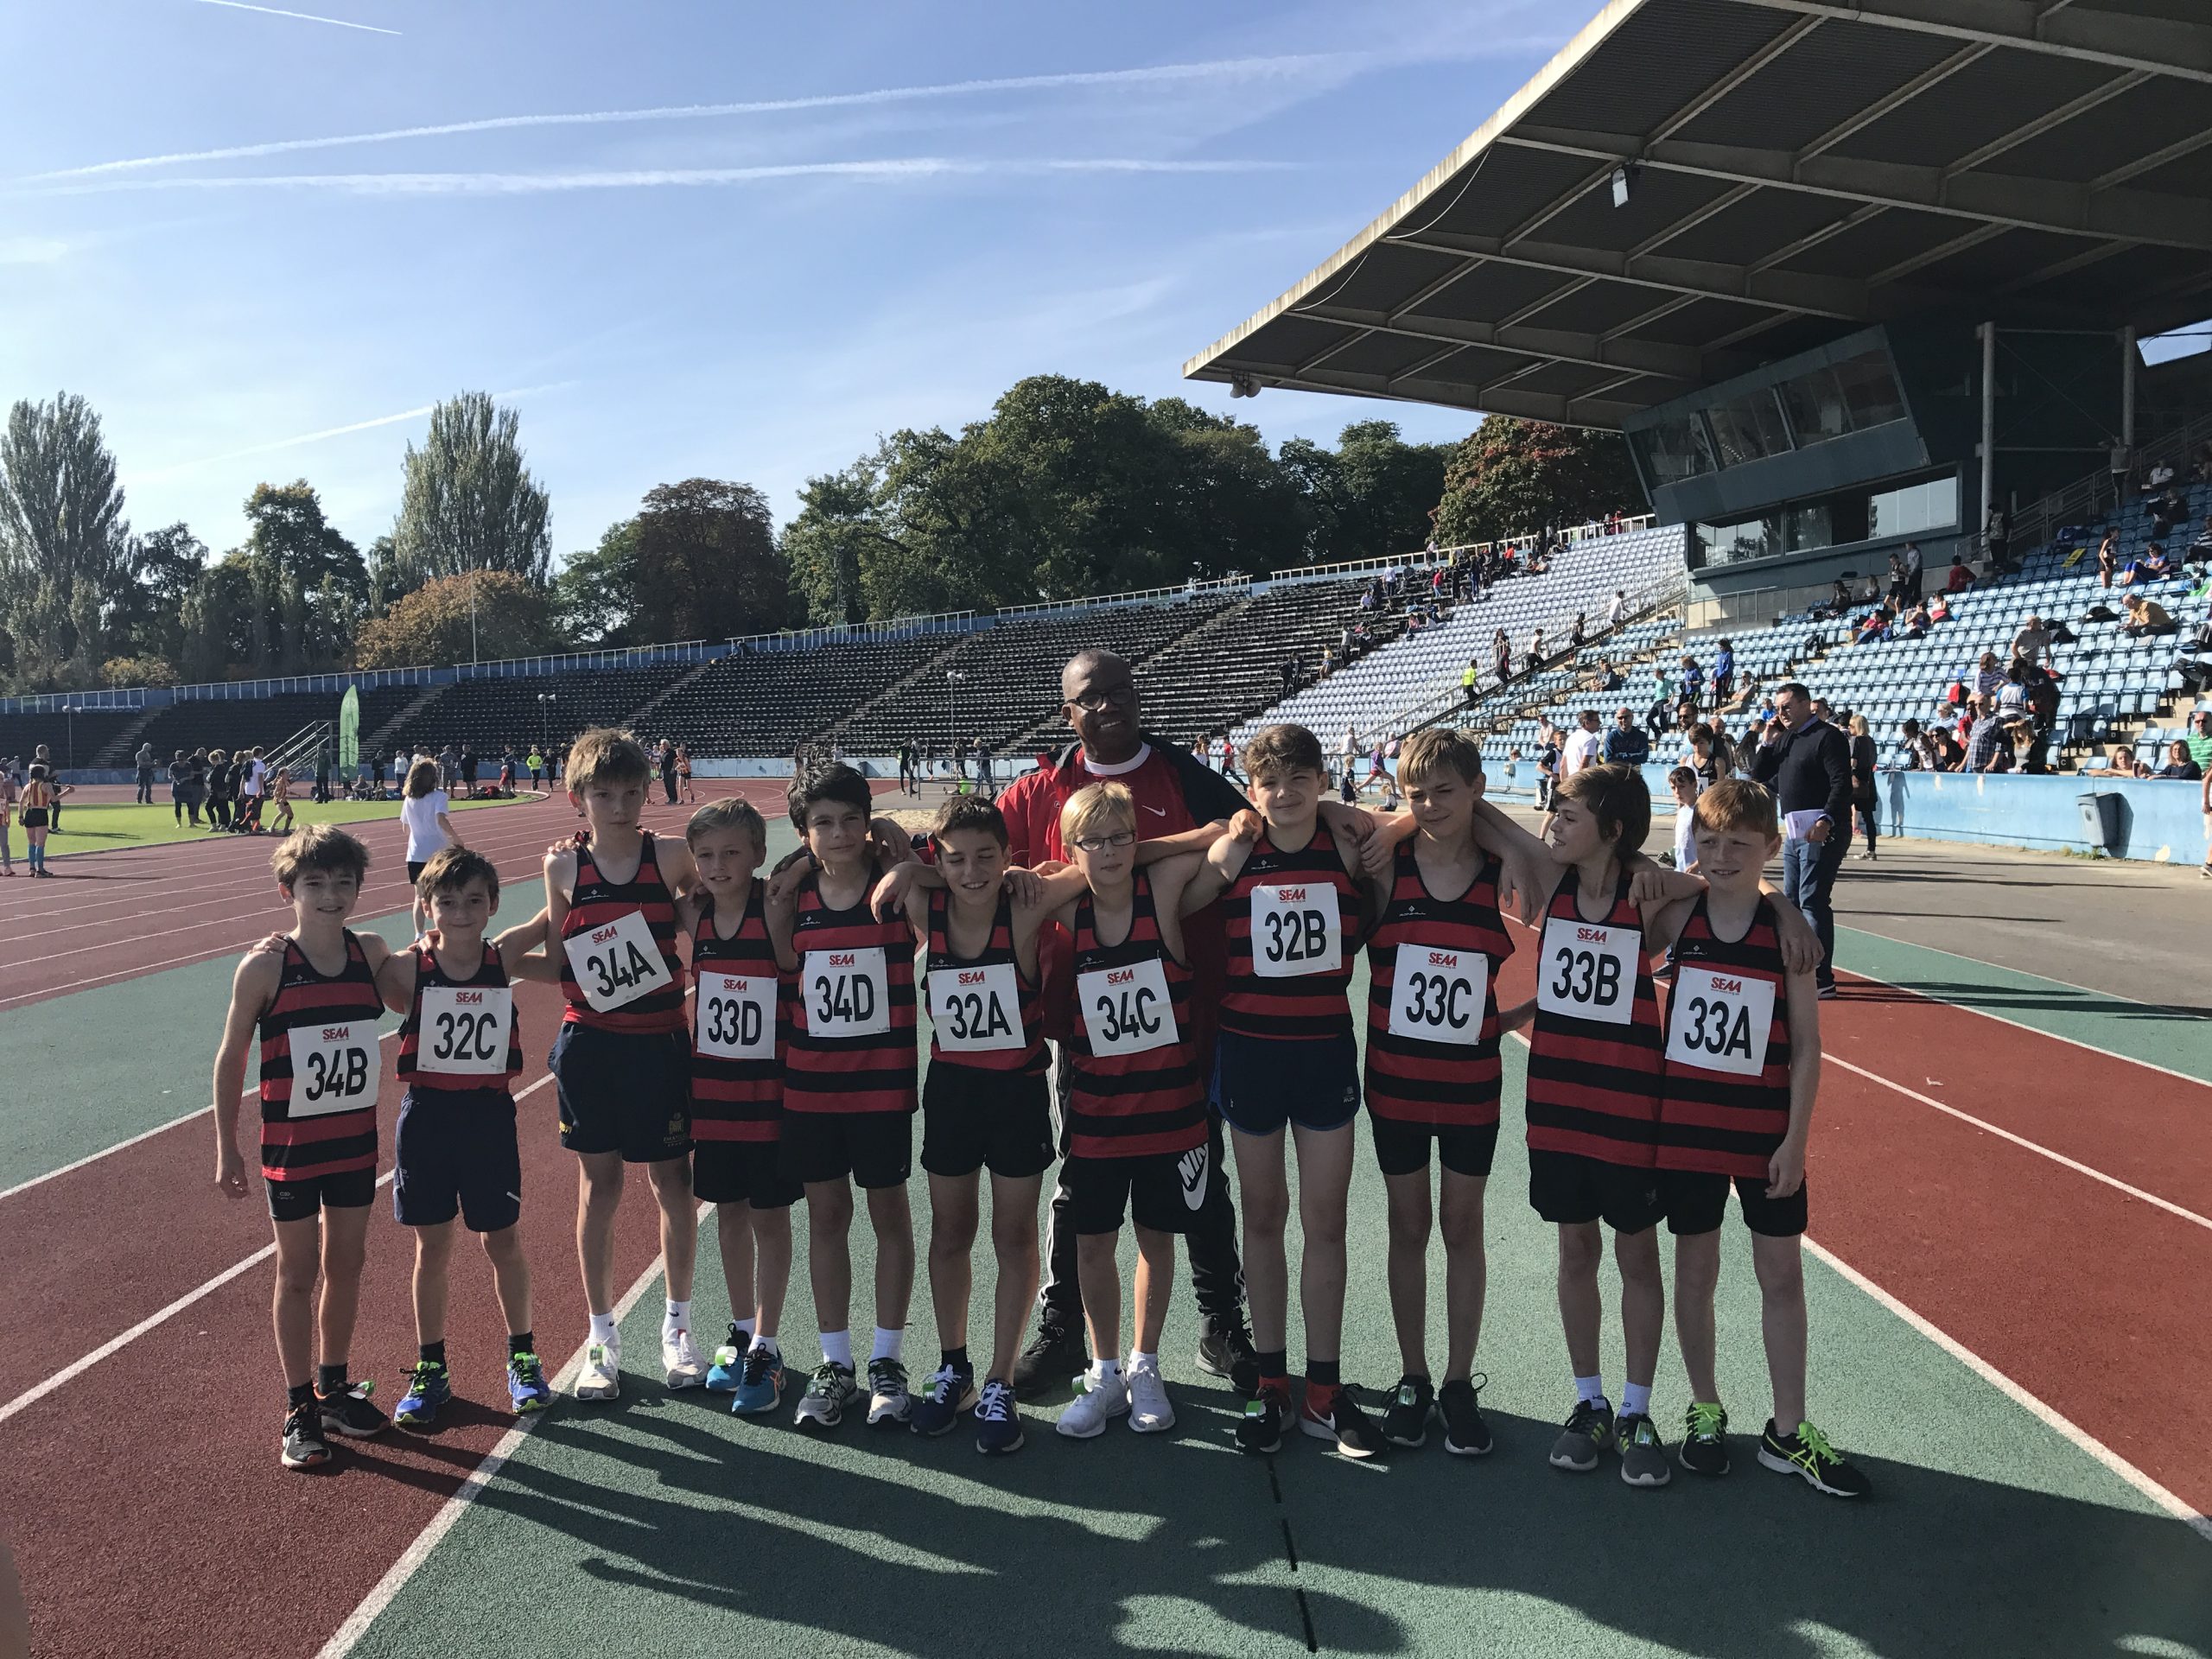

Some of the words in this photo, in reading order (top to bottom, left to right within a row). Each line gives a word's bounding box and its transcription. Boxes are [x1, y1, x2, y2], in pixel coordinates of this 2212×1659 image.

[1279, 888, 1306, 900] SEAA
[592, 926, 618, 944] SEAA
[1264, 910, 1326, 962] 32B
[1577, 927, 1606, 942] SEAA
[588, 940, 657, 997] 34A
[830, 954, 855, 965] SEAA
[1428, 952, 1458, 966] SEAA
[724, 979, 747, 990] SEAA
[958, 971, 985, 983] SEAA
[1107, 969, 1134, 983] SEAA
[1553, 947, 1621, 1006] 33B
[1711, 977, 1741, 993] SEAA
[456, 992, 482, 1002] SEAA
[816, 974, 874, 1023] 34D
[1406, 972, 1471, 1029] 33C
[708, 997, 761, 1046] 33D
[946, 991, 1012, 1039] 32A
[1097, 988, 1160, 1041] 34C
[1684, 996, 1751, 1059] 33A
[322, 1027, 349, 1040] SEAA
[434, 1012, 498, 1060] 32C
[306, 1047, 368, 1101] 34B
